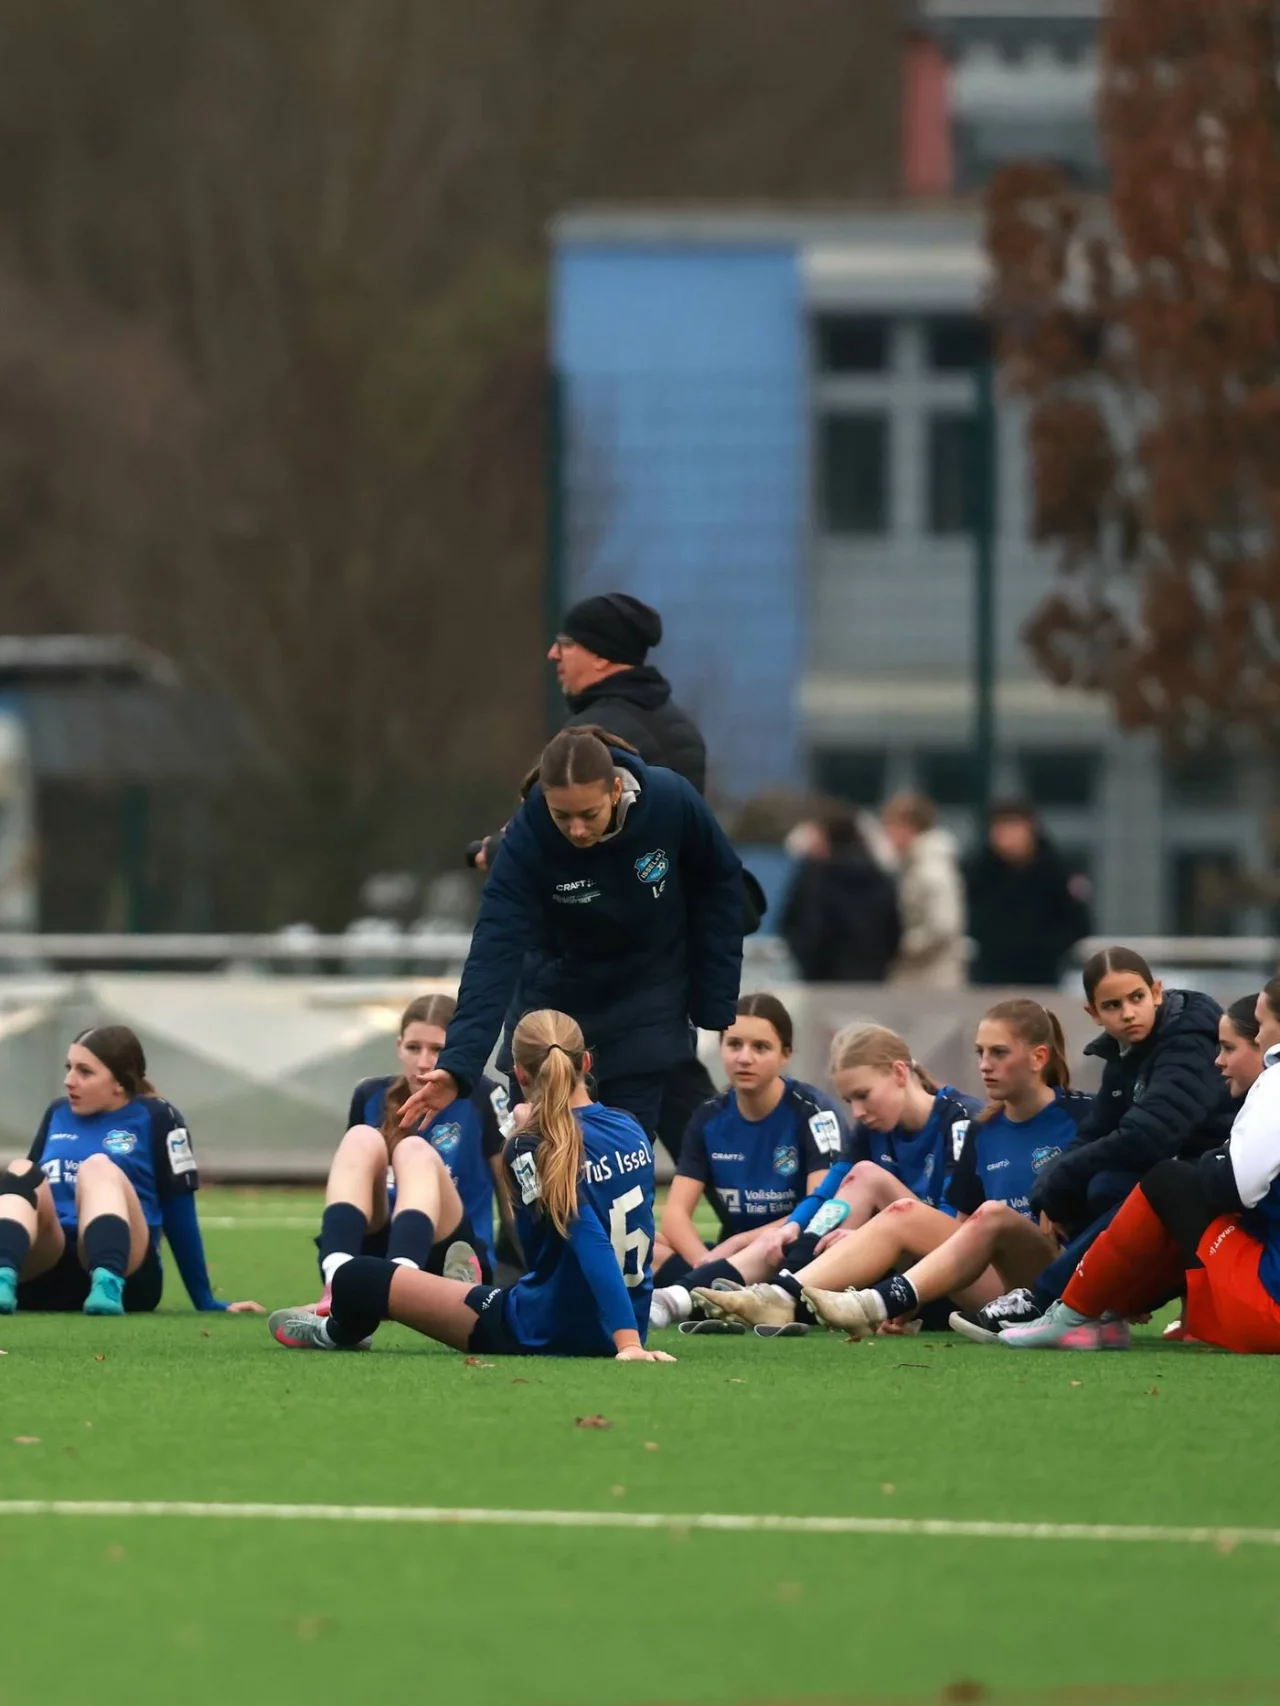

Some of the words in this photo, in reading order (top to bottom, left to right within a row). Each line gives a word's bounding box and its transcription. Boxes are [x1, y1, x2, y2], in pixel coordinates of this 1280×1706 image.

[556, 880, 586, 891] CRAFT
[582, 1155, 613, 1184] TuS
[614, 1140, 652, 1175] Issel
[711, 1152, 738, 1161] CRAFT
[744, 1188, 796, 1201] Volksbank
[744, 1202, 767, 1214] Trier
[609, 1184, 651, 1288] 6
[1214, 1225, 1235, 1249] CRAFT
